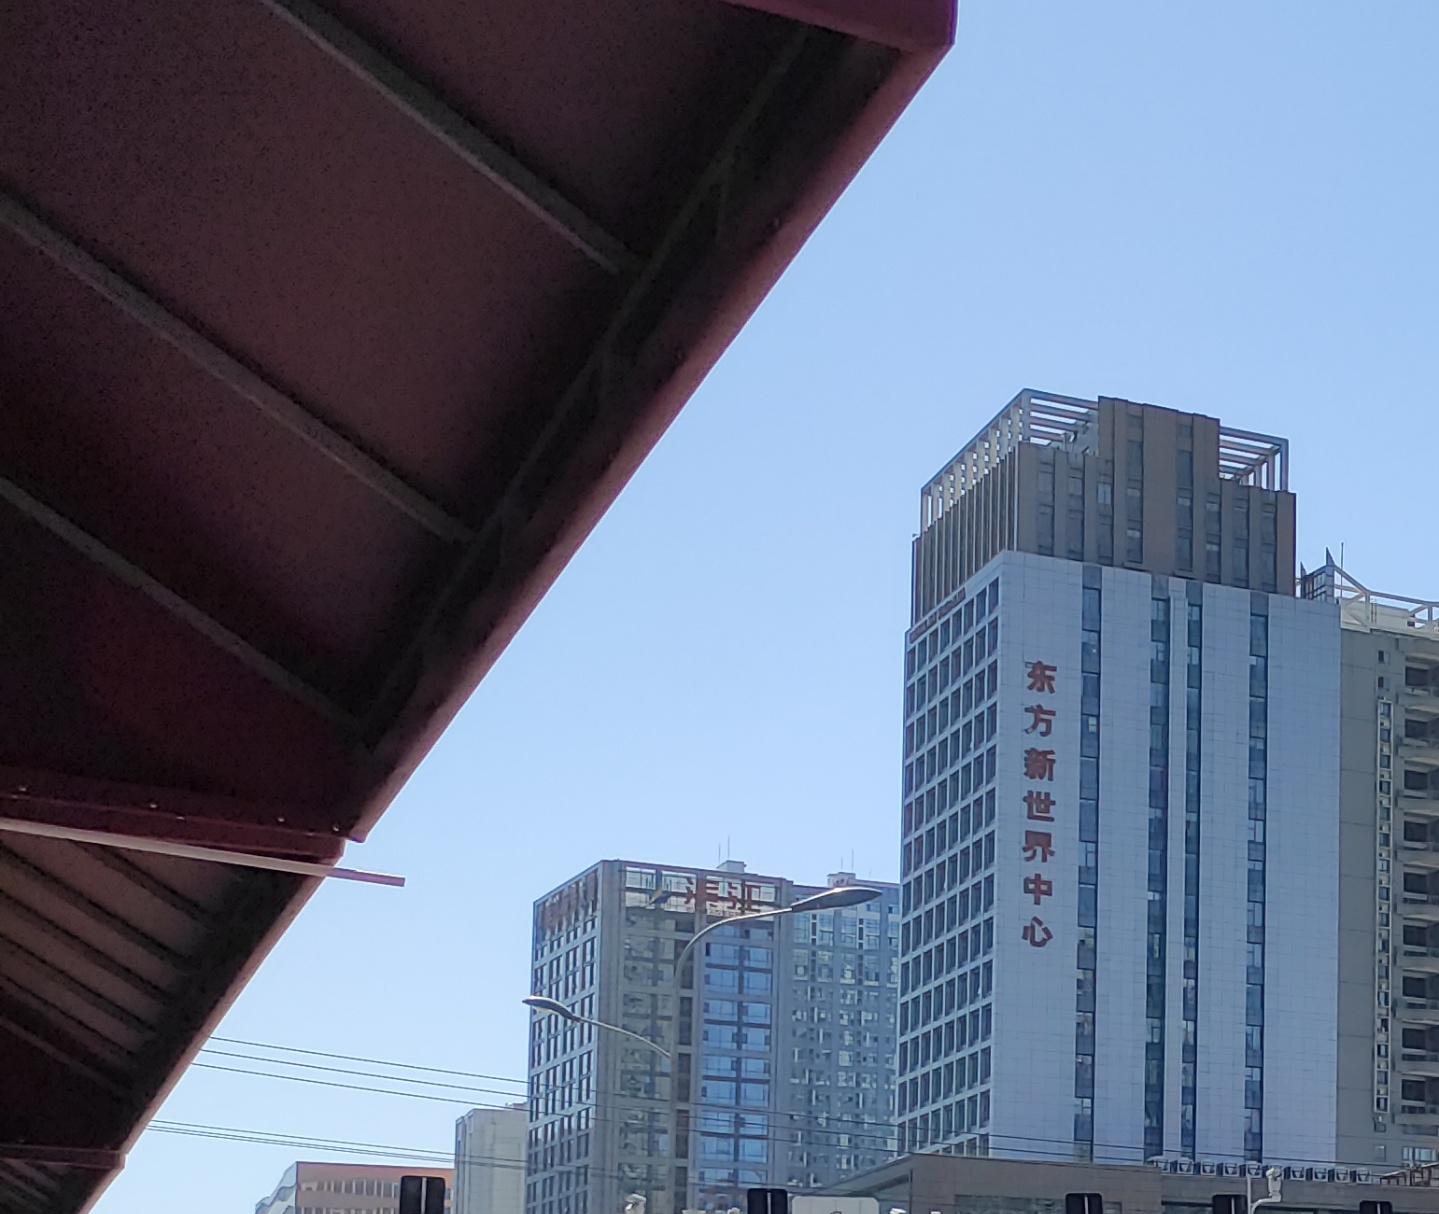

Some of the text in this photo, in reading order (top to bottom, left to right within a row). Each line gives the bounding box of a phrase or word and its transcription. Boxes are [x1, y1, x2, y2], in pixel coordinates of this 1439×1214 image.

[1021, 660, 1057, 949] 东方新世界中心
